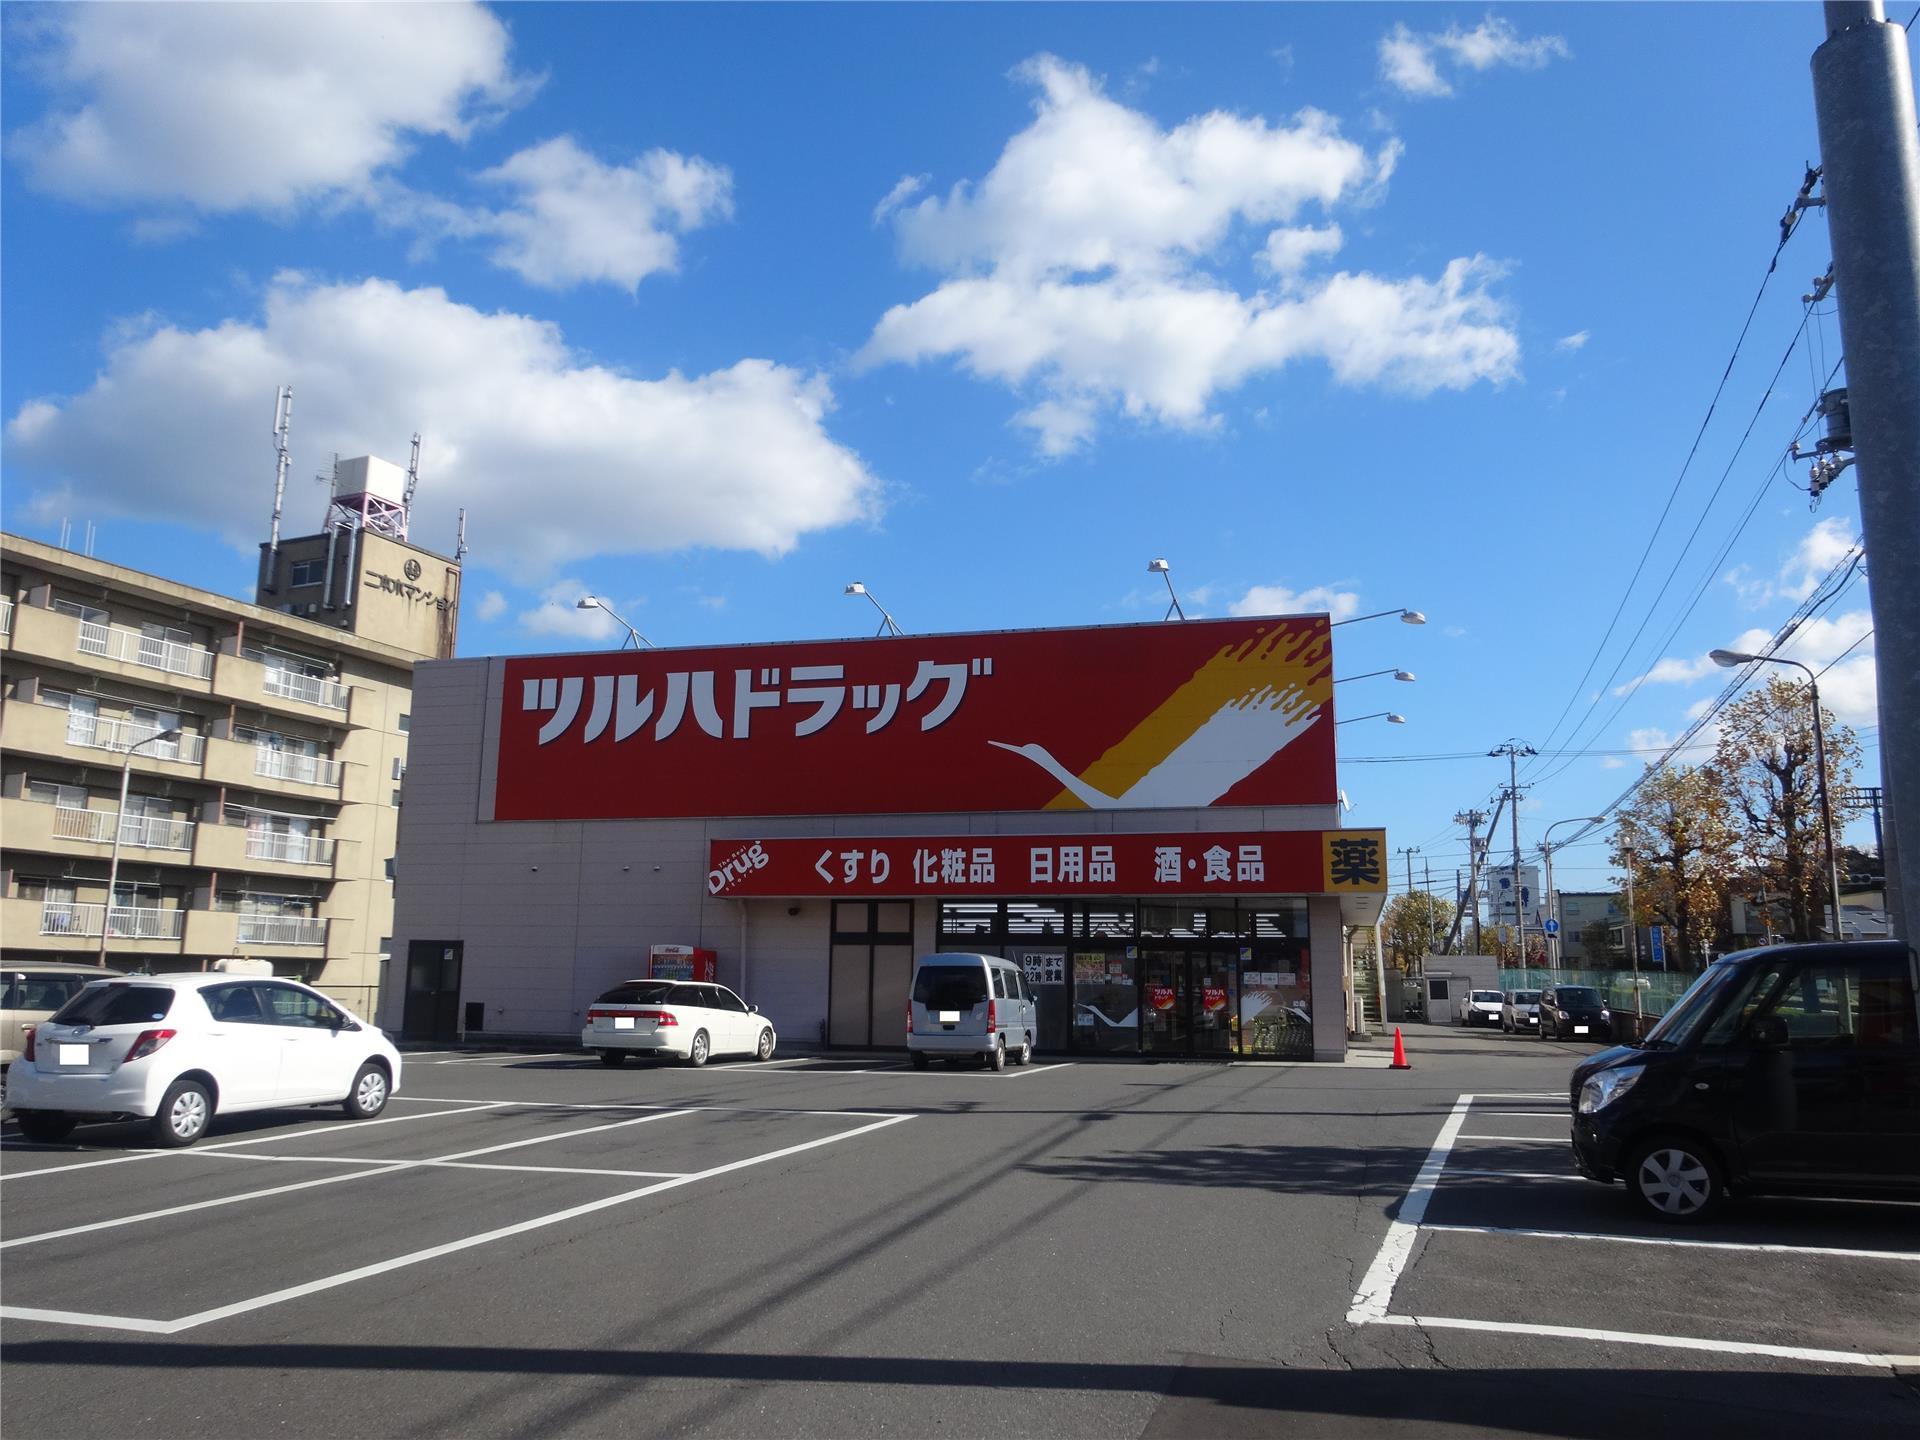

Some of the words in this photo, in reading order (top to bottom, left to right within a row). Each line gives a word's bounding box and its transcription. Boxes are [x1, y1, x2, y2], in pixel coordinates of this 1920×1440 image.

[522, 657, 993, 746] ツルハドラッグ
[708, 840, 770, 895] Drug
[814, 848, 890, 884] くすり
[912, 847, 995, 884] 化粧品
[1030, 845, 1116, 883] 日用品
[1154, 845, 1265, 883] 酒・食品
[1330, 838, 1380, 885] 薬
[1025, 955, 1042, 967] 9時
[1045, 957, 1063, 967] まで
[1045, 969, 1063, 982] 営業
[1154, 988, 1174, 996] ツルハ
[1205, 988, 1225, 996] ツルハ
